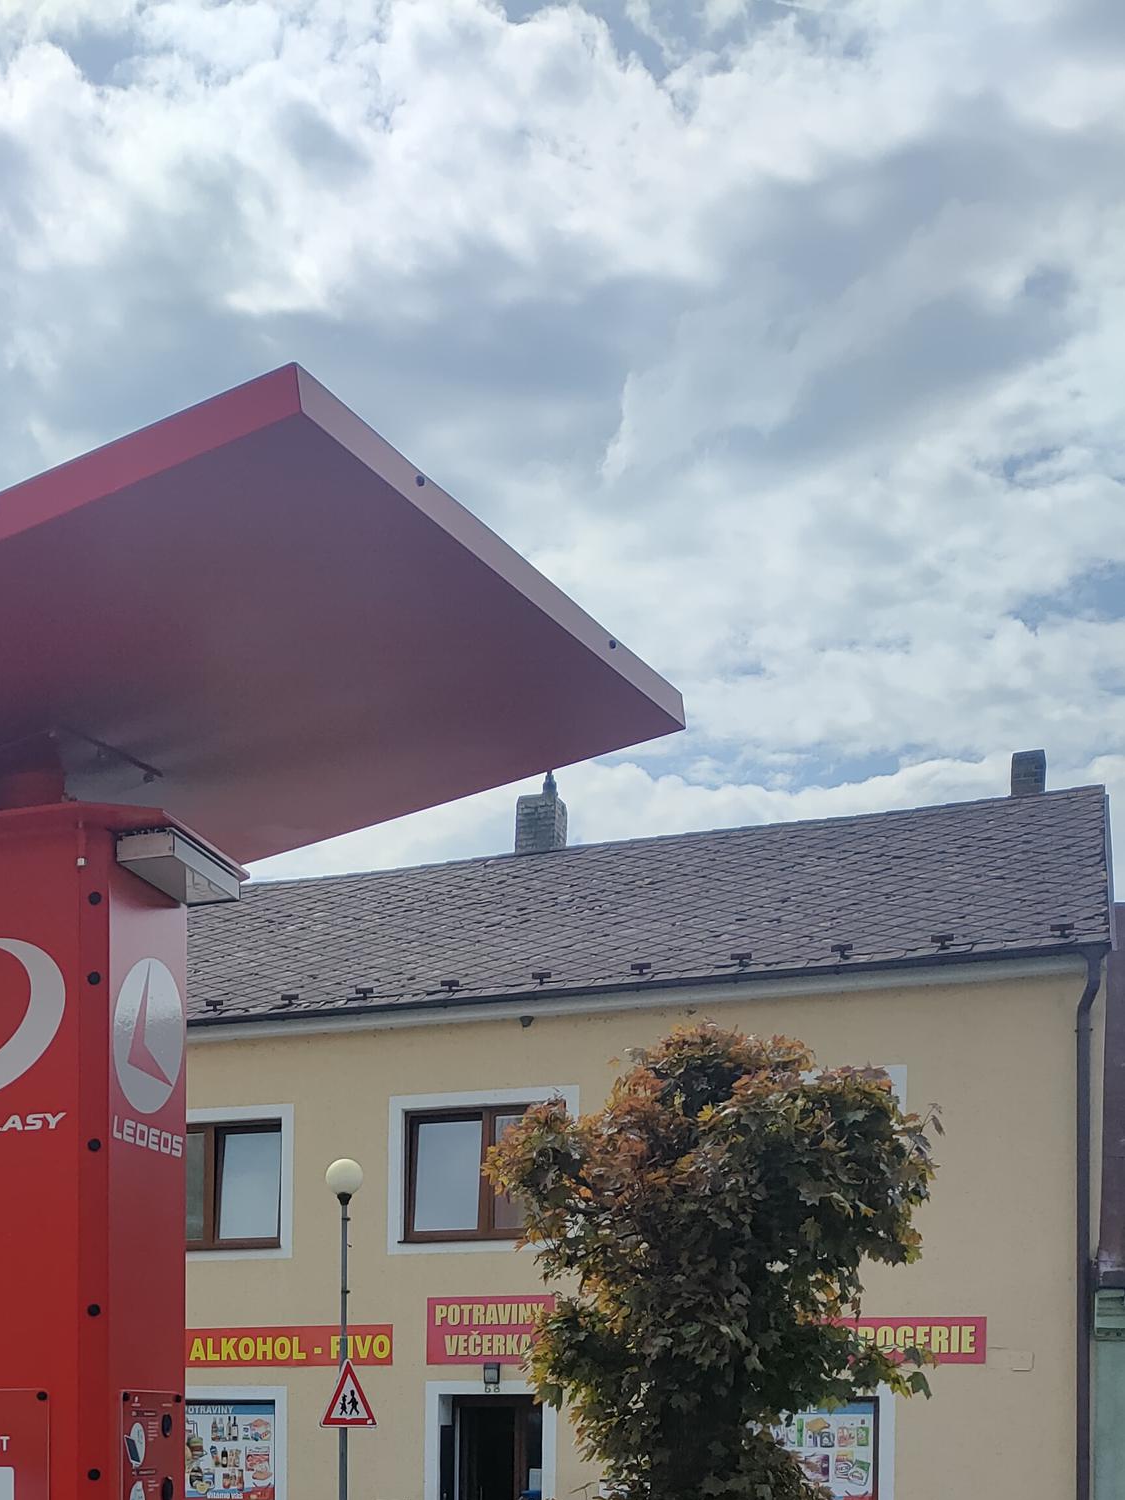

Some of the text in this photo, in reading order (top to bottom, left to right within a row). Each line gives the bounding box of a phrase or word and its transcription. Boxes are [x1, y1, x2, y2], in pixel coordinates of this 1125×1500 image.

[112, 1115, 183, 1158] LEDEOS
[189, 1336, 307, 1361] ALKOHOL
[314, 1346, 323, 1355] -
